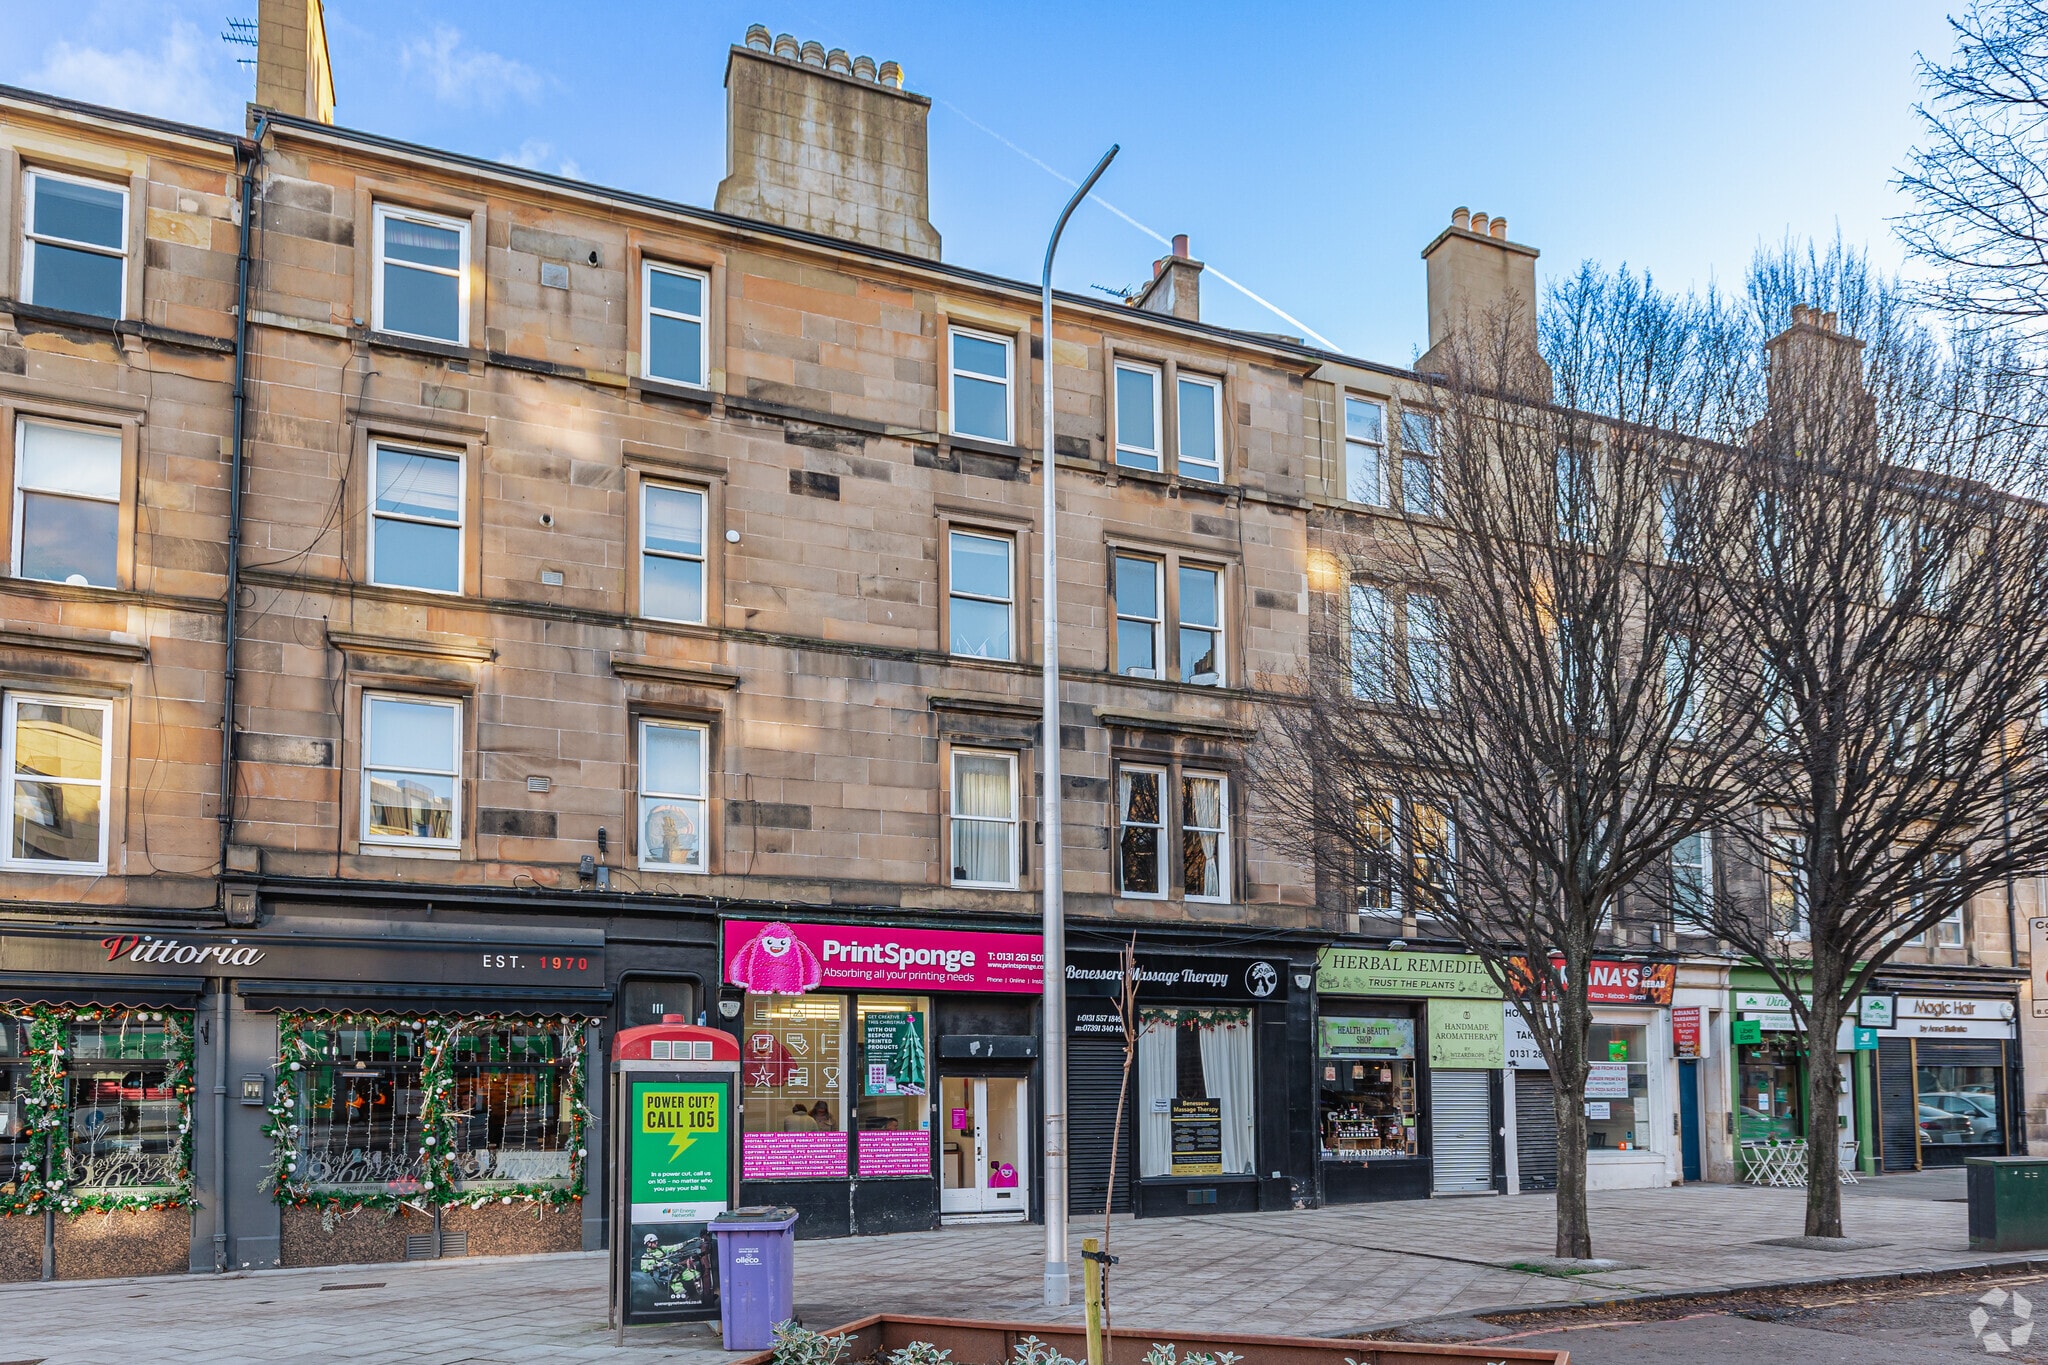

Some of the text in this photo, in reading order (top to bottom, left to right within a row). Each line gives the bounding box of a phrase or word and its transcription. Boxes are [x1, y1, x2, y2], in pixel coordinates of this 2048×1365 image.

[101, 935, 266, 966] Vittoria
[823, 940, 976, 972] PrintSponge
[483, 955, 588, 971] EST. 1970
[988, 952, 1044, 963] T: 0131 261 501
[1332, 954, 1402, 971] HERBAL
[987, 962, 1044, 971] www.printsponge.co
[823, 967, 975, 983] Absorbing all your printing needs
[1066, 965, 1229, 988] Benessere Massage Therapy
[1368, 978, 1456, 989] TRUST THE PLANTS
[1641, 980, 1666, 989] KEBAB
[1765, 995, 1790, 1007] Dine
[1505, 1008, 1523, 1018] HO
[1914, 1000, 1976, 1017] Magic Hair
[1095, 1014, 1108, 1022] 557
[1337, 1026, 1362, 1035] HEALTH
[1366, 1026, 1391, 1036] BEAUTY
[1444, 1023, 1490, 1031] HANDMADE
[1356, 1036, 1373, 1045] SHOP
[1435, 1032, 1498, 1041] AROMATHERAPY
[1516, 1031, 1536, 1040] TAK
[1509, 1050, 1544, 1059] 0131 28
[647, 1096, 715, 1109] POWER CUT?
[647, 1111, 715, 1128] CALL 105
[1339, 1149, 1393, 1157] WIZARDROPS
